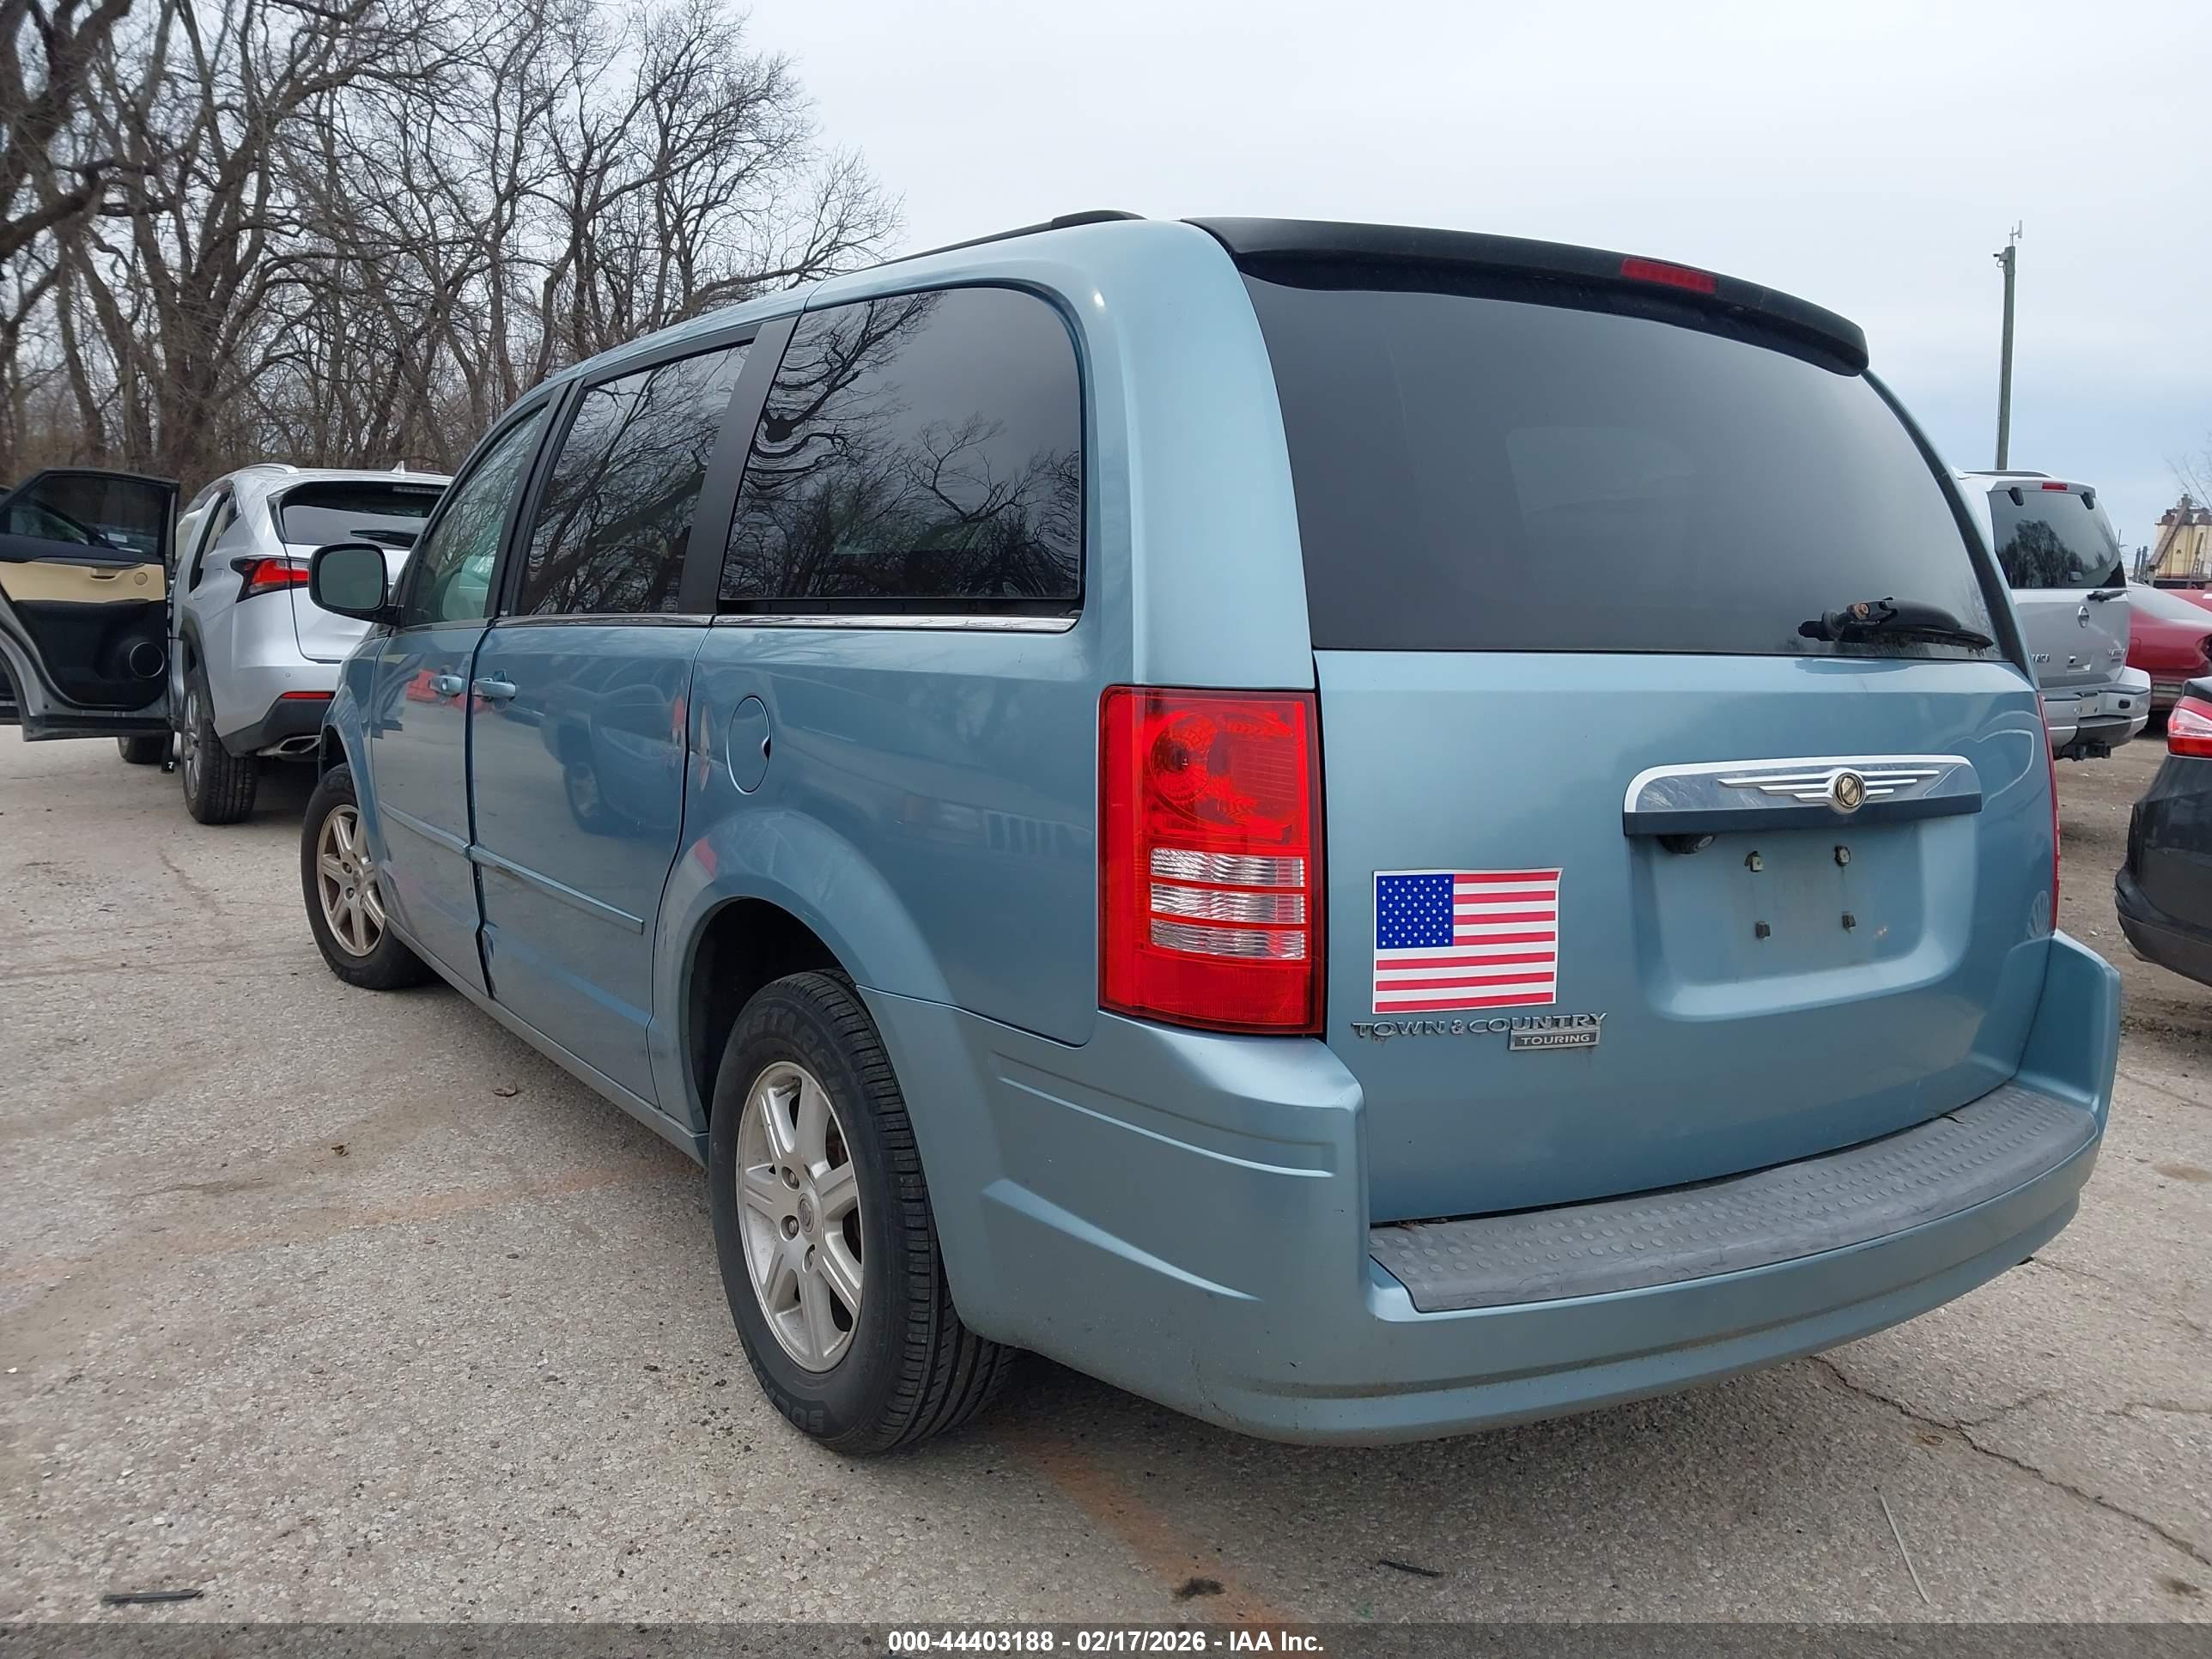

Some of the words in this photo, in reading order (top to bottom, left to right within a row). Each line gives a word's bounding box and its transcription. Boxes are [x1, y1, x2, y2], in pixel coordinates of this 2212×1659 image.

[1352, 1019, 1446, 1037] TOWN
[1449, 1018, 1465, 1036] &
[1468, 1012, 1607, 1034] COUNTRY
[1521, 1033, 1590, 1045] TOURING
